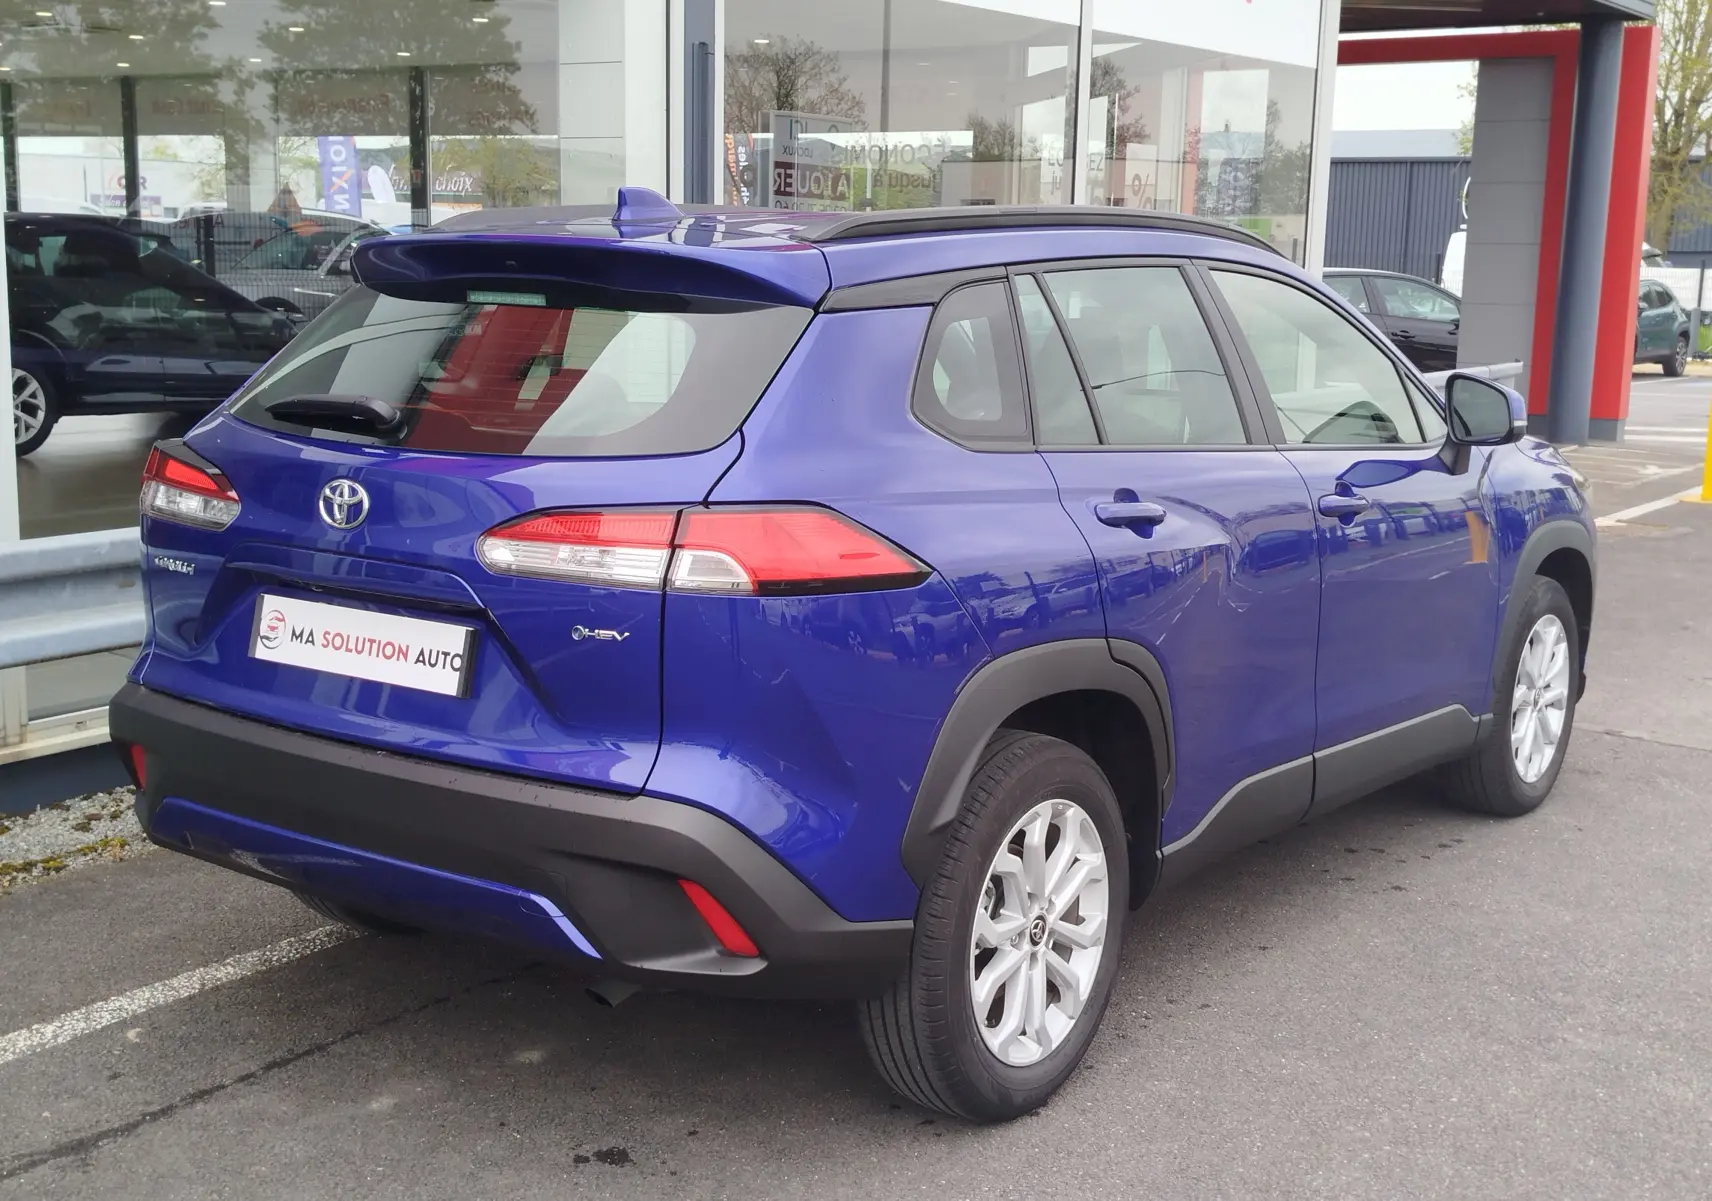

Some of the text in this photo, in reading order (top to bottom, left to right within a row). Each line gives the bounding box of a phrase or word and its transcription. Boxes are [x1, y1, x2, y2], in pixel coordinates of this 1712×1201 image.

[290, 625, 463, 673] MA SOLUTION AUTO
